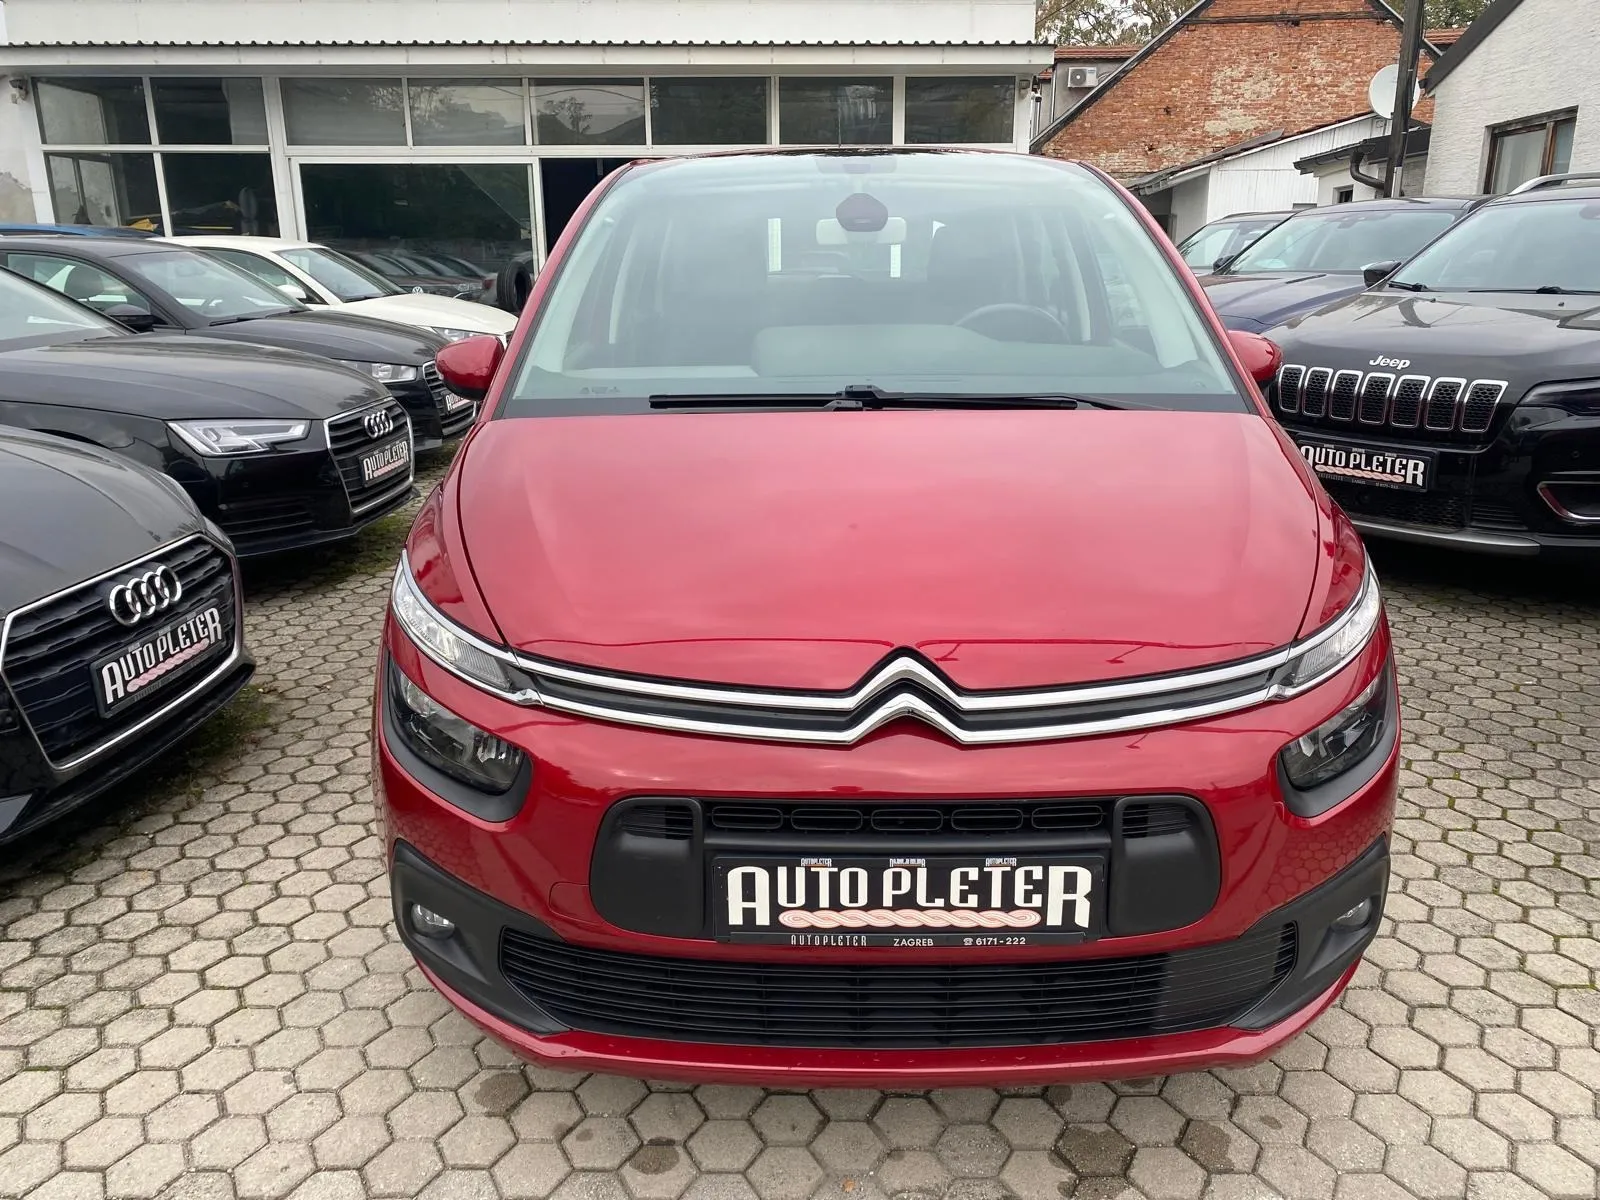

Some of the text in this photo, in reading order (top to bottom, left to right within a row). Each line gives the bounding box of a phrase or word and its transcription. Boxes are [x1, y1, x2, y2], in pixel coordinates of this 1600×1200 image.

[1369, 355, 1411, 370] Jeep
[363, 441, 409, 480] AUTO PLETER
[1349, 452, 1425, 486] PLETER
[101, 641, 154, 704] AUTO
[156, 607, 222, 662] PLETER
[727, 865, 1091, 928] AUTO PLETER
[790, 934, 867, 947] AUTOPLETER
[893, 938, 934, 947] ZAGREB
